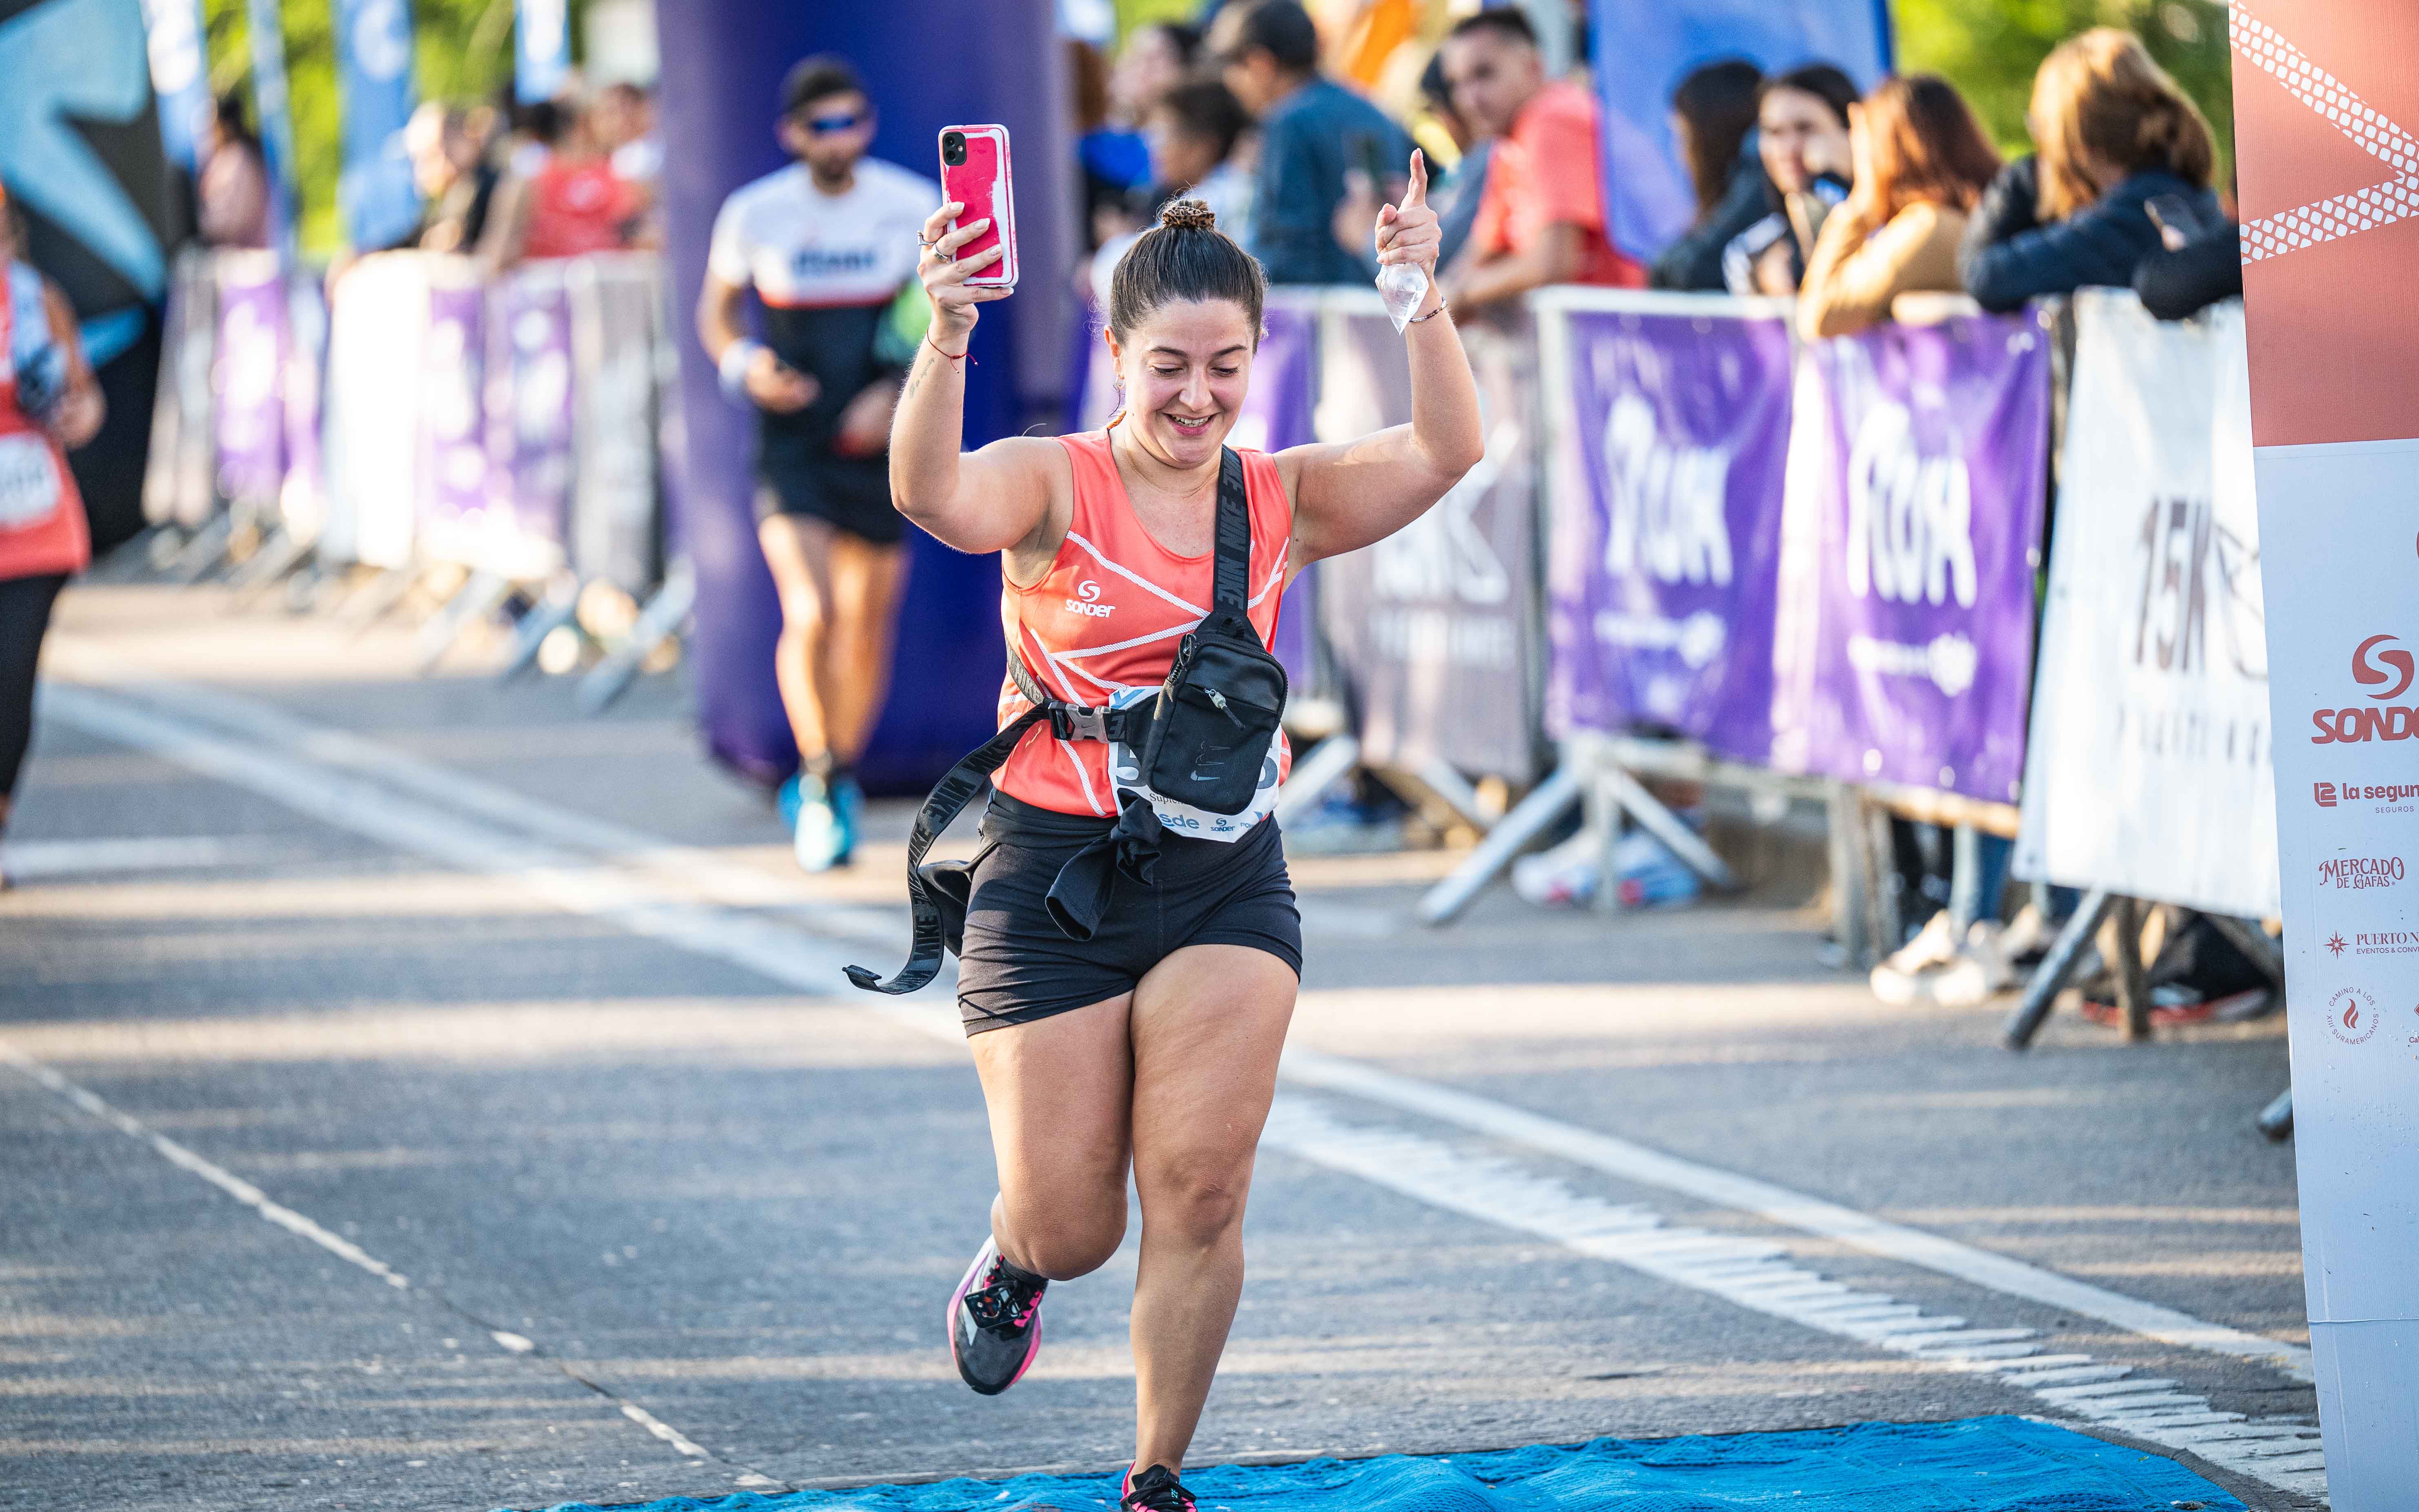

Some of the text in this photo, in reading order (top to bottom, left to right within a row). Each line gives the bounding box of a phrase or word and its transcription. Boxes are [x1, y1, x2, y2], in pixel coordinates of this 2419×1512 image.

[1220, 495, 1246, 552] NIKE
[1217, 554, 1244, 611] NIKE
[2312, 706, 2419, 744] SOND
[922, 776, 977, 824] NIKE
[2342, 783, 2360, 799] la
[1159, 813, 1200, 829] sde
[2319, 857, 2404, 885] MERCADO
[2337, 874, 2390, 889] DE GAFAS
[905, 914, 938, 961] NIKE
[2357, 932, 2407, 945] PUERTO
[2329, 987, 2354, 1006] CAMINO
[2363, 992, 2375, 1006] LOS
[2332, 1013, 2379, 1045] SURAMERICANOS
